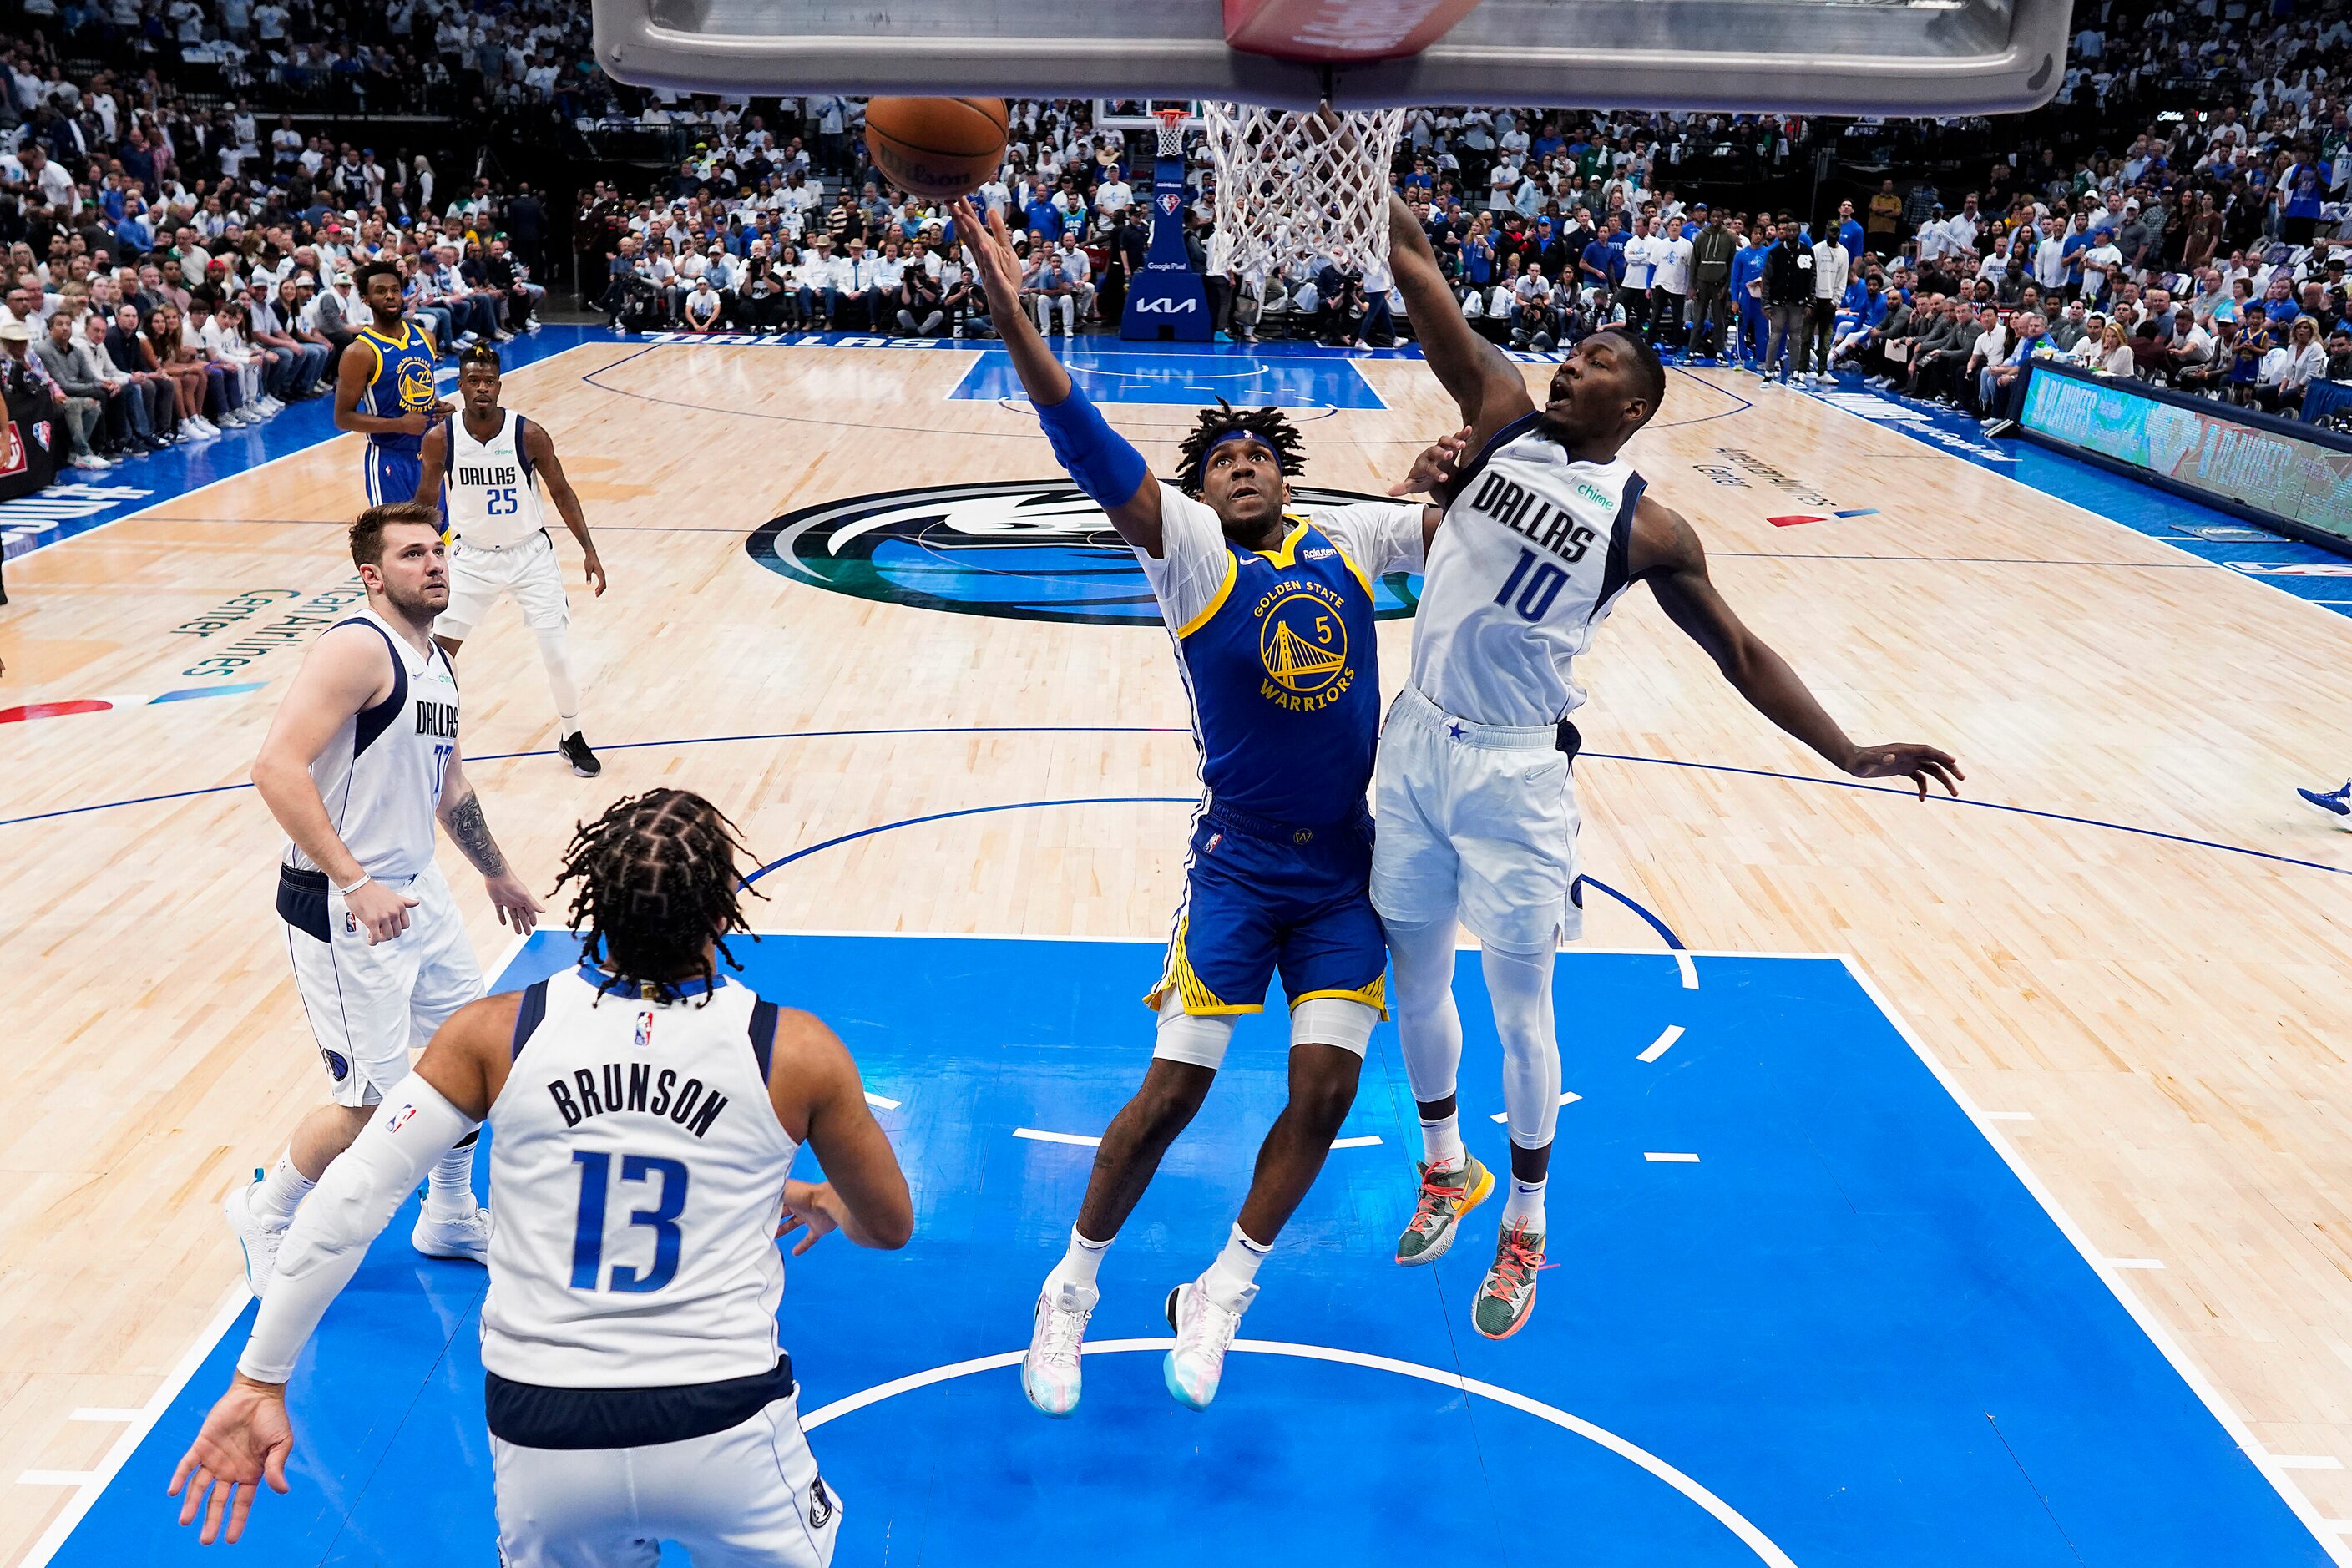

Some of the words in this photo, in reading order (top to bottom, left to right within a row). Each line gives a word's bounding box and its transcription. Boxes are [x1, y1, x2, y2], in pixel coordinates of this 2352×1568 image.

[1148, 261, 1171, 271] Google
[1136, 297, 1196, 313] KIA
[396, 357, 413, 374] GOLDEN
[413, 356, 432, 367] STATE
[417, 371, 432, 384] 22
[459, 466, 516, 485] DALLAS
[487, 488, 518, 515] 25
[1577, 483, 1614, 511] chime
[1469, 469, 1596, 565] DALLAS
[1303, 547, 1338, 560] Rakuten
[1254, 580, 1302, 618] GOLDEN
[1306, 581, 1345, 609] STATE
[1493, 545, 1571, 624] 10
[169, 589, 301, 638] Center
[1315, 615, 1333, 645] 5
[182, 615, 333, 677] Airlines
[1260, 666, 1355, 712] WARRIORS
[415, 700, 458, 738] DALLAS
[433, 744, 453, 794] 77
[547, 1062, 729, 1139] BRUNSON
[569, 1149, 690, 1295] 13
